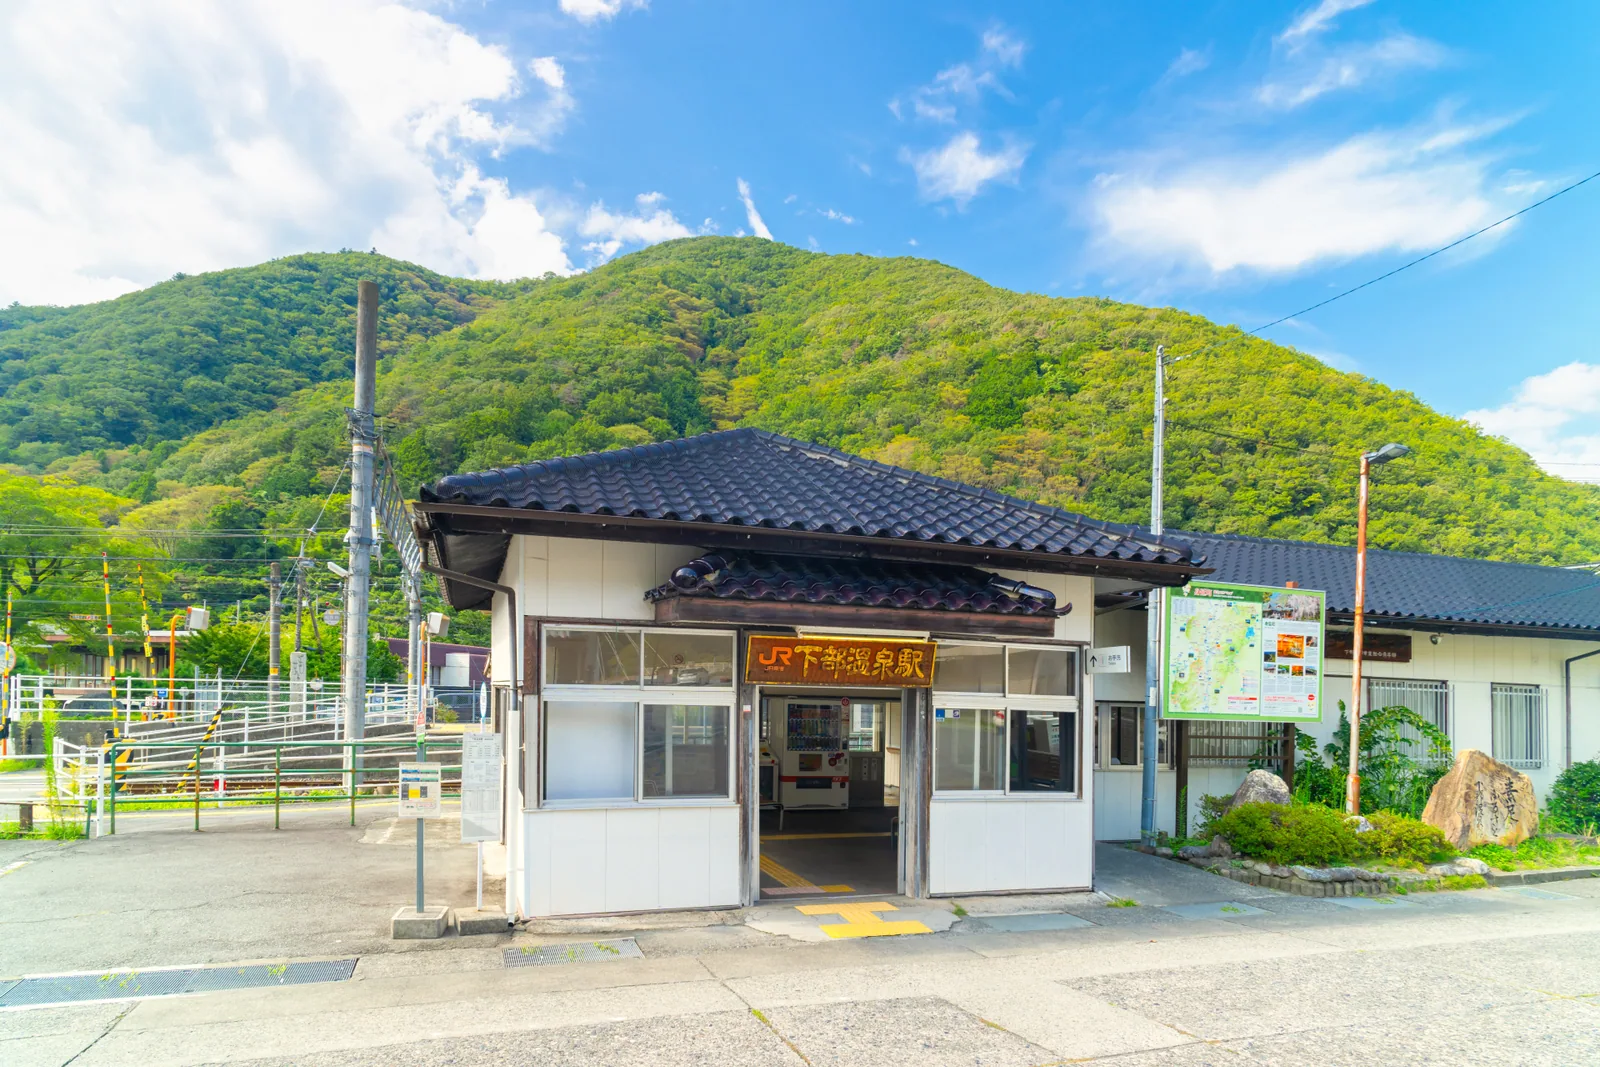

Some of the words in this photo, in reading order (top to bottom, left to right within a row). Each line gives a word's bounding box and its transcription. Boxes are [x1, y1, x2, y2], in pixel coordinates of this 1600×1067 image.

[759, 647, 792, 665] JR
[794, 645, 925, 680] 下部温泉駅
